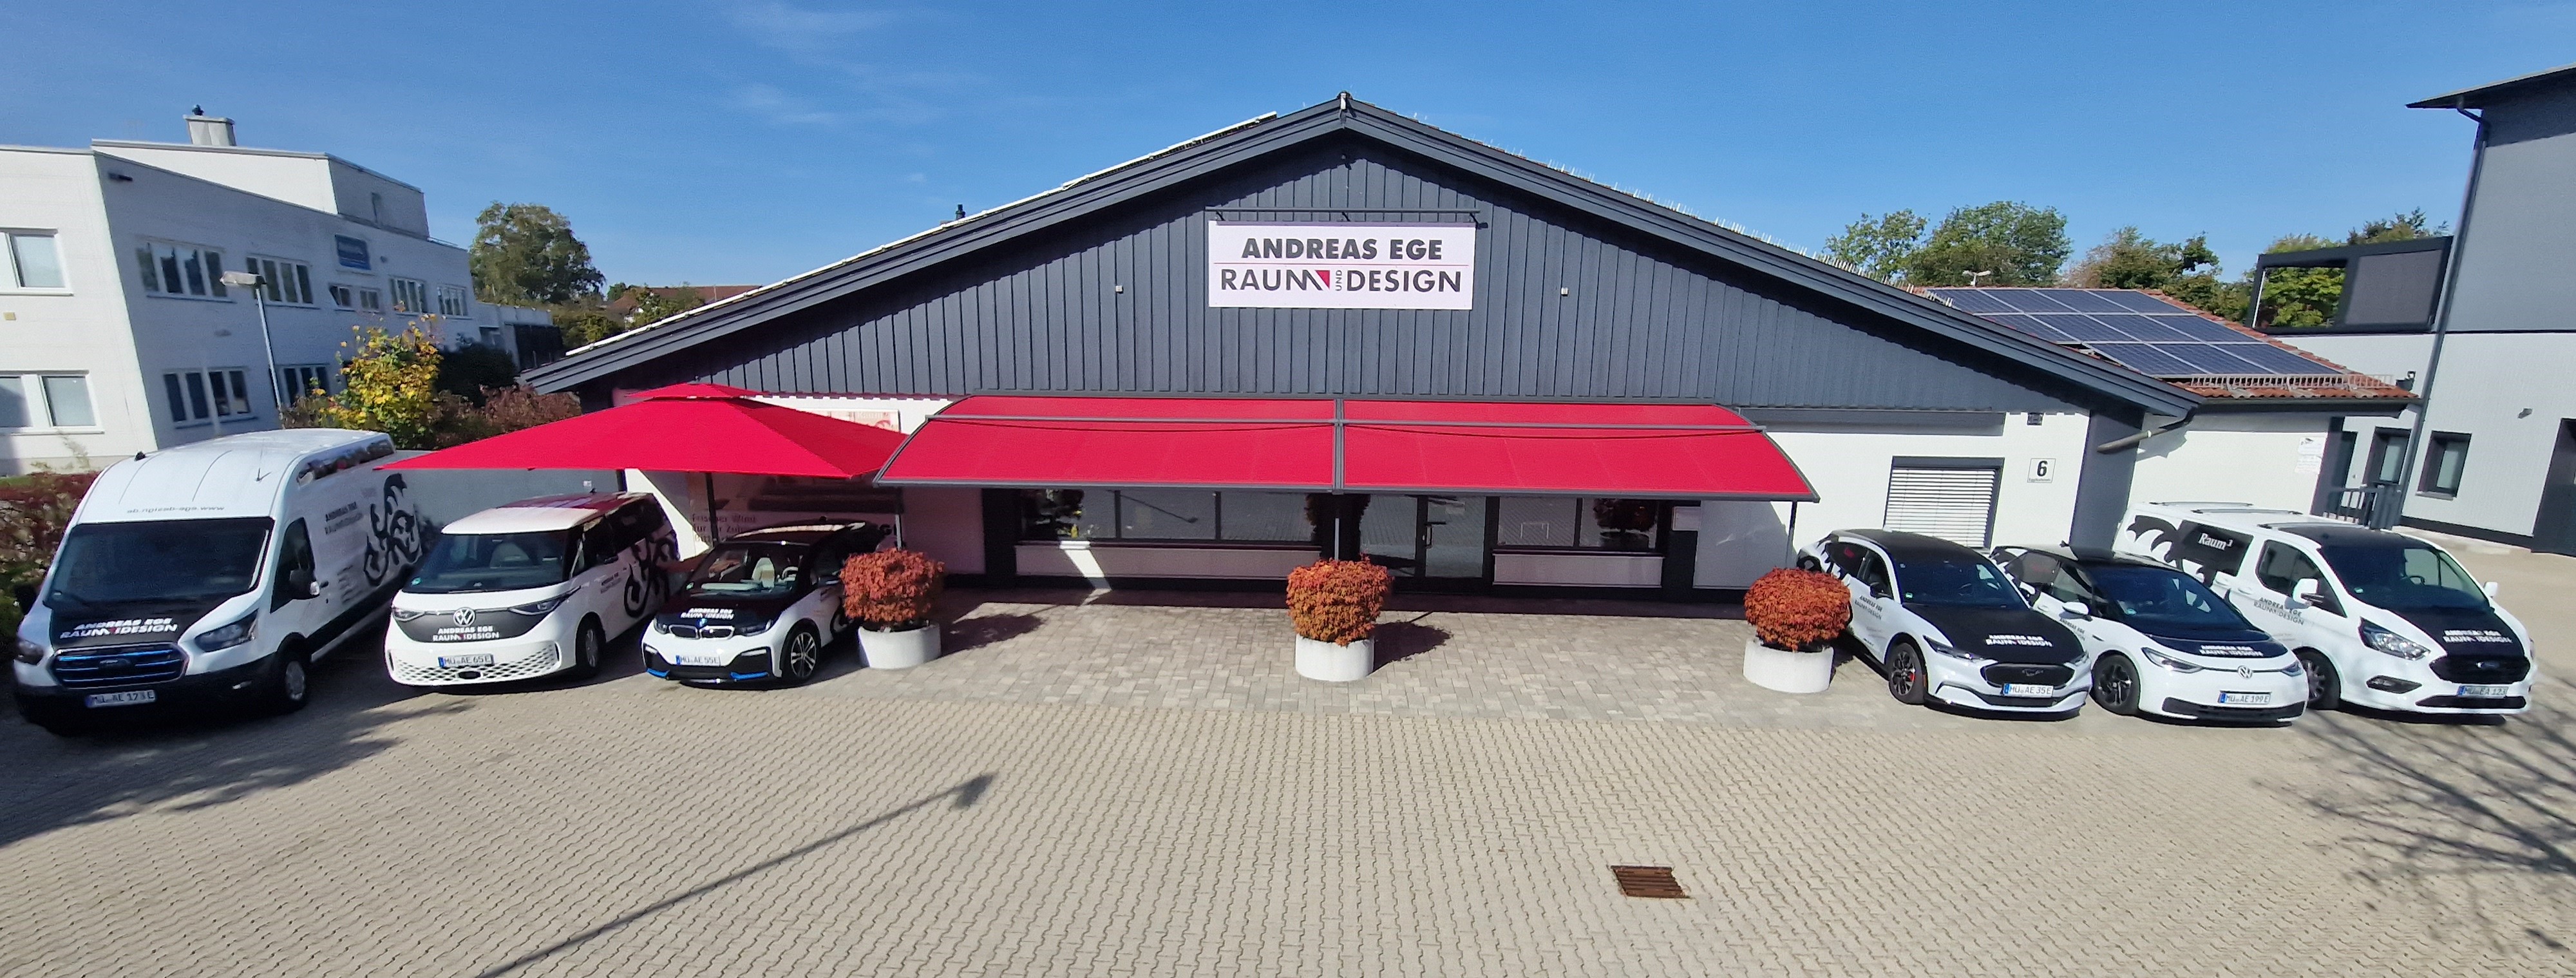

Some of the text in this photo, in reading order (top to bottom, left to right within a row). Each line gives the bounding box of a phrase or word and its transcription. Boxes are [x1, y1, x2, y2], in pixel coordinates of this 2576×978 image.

[1241, 238, 1442, 260] ANDREAS EGE
[1221, 269, 1323, 291] RAUM
[1347, 269, 1461, 292] DESIGN
[2036, 460, 2049, 477] 6
[2259, 597, 2284, 611] ANDREA
[73, 618, 142, 631] ANDREAS
[438, 626, 476, 635] ANDREAS
